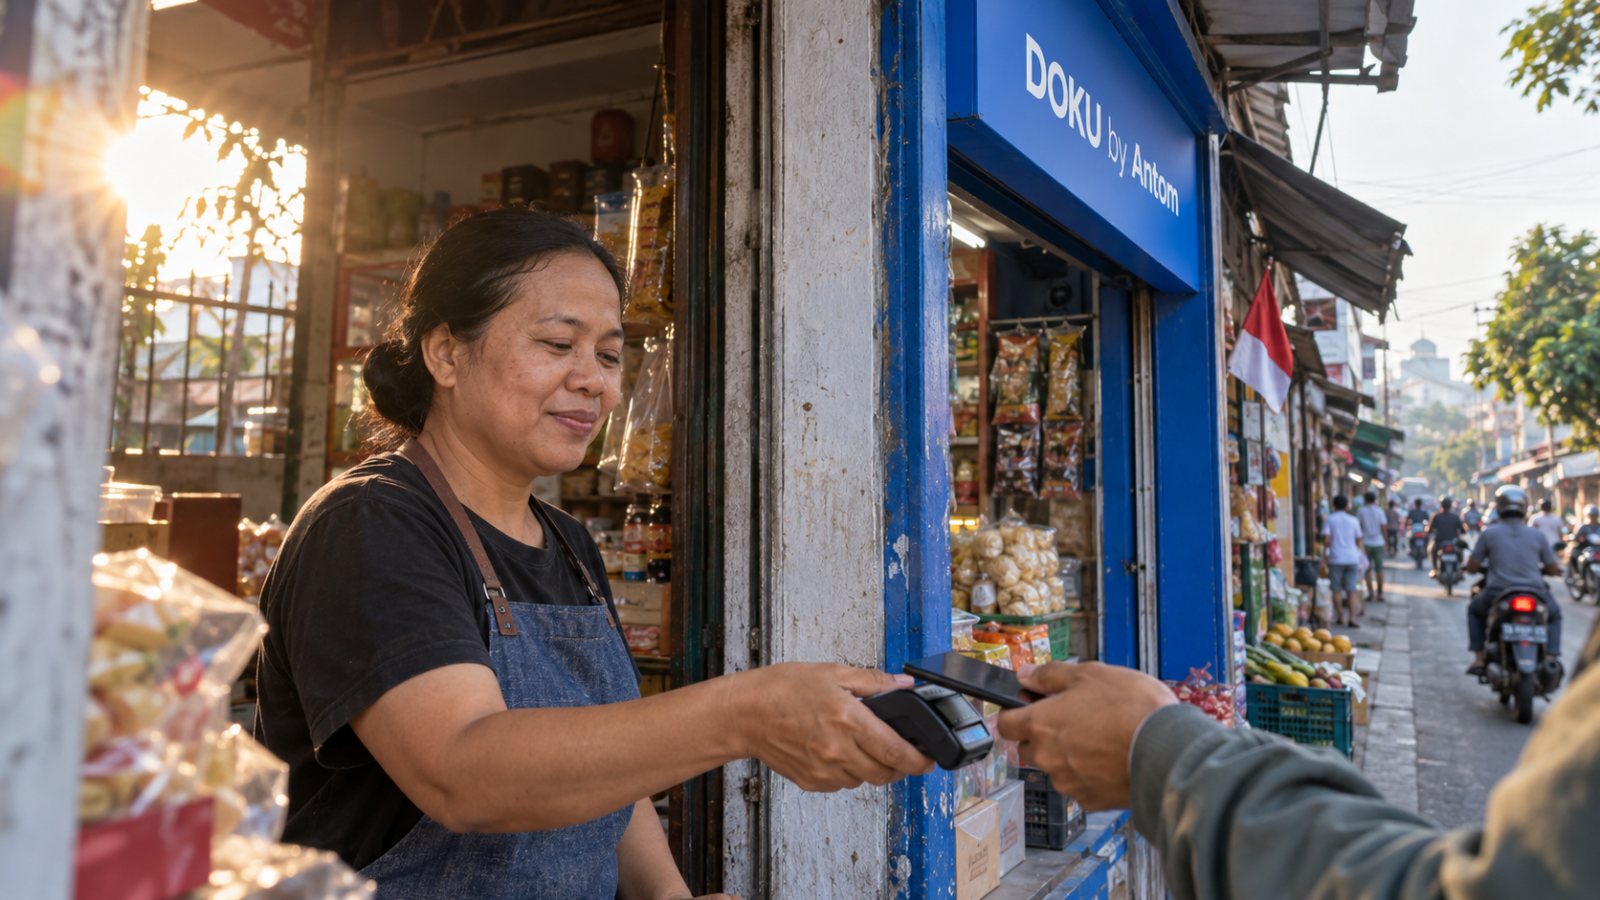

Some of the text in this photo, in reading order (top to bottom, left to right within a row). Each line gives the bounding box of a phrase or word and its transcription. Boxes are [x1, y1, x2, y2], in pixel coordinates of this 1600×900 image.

[1026, 33, 1179, 216] DOKU by Antom
